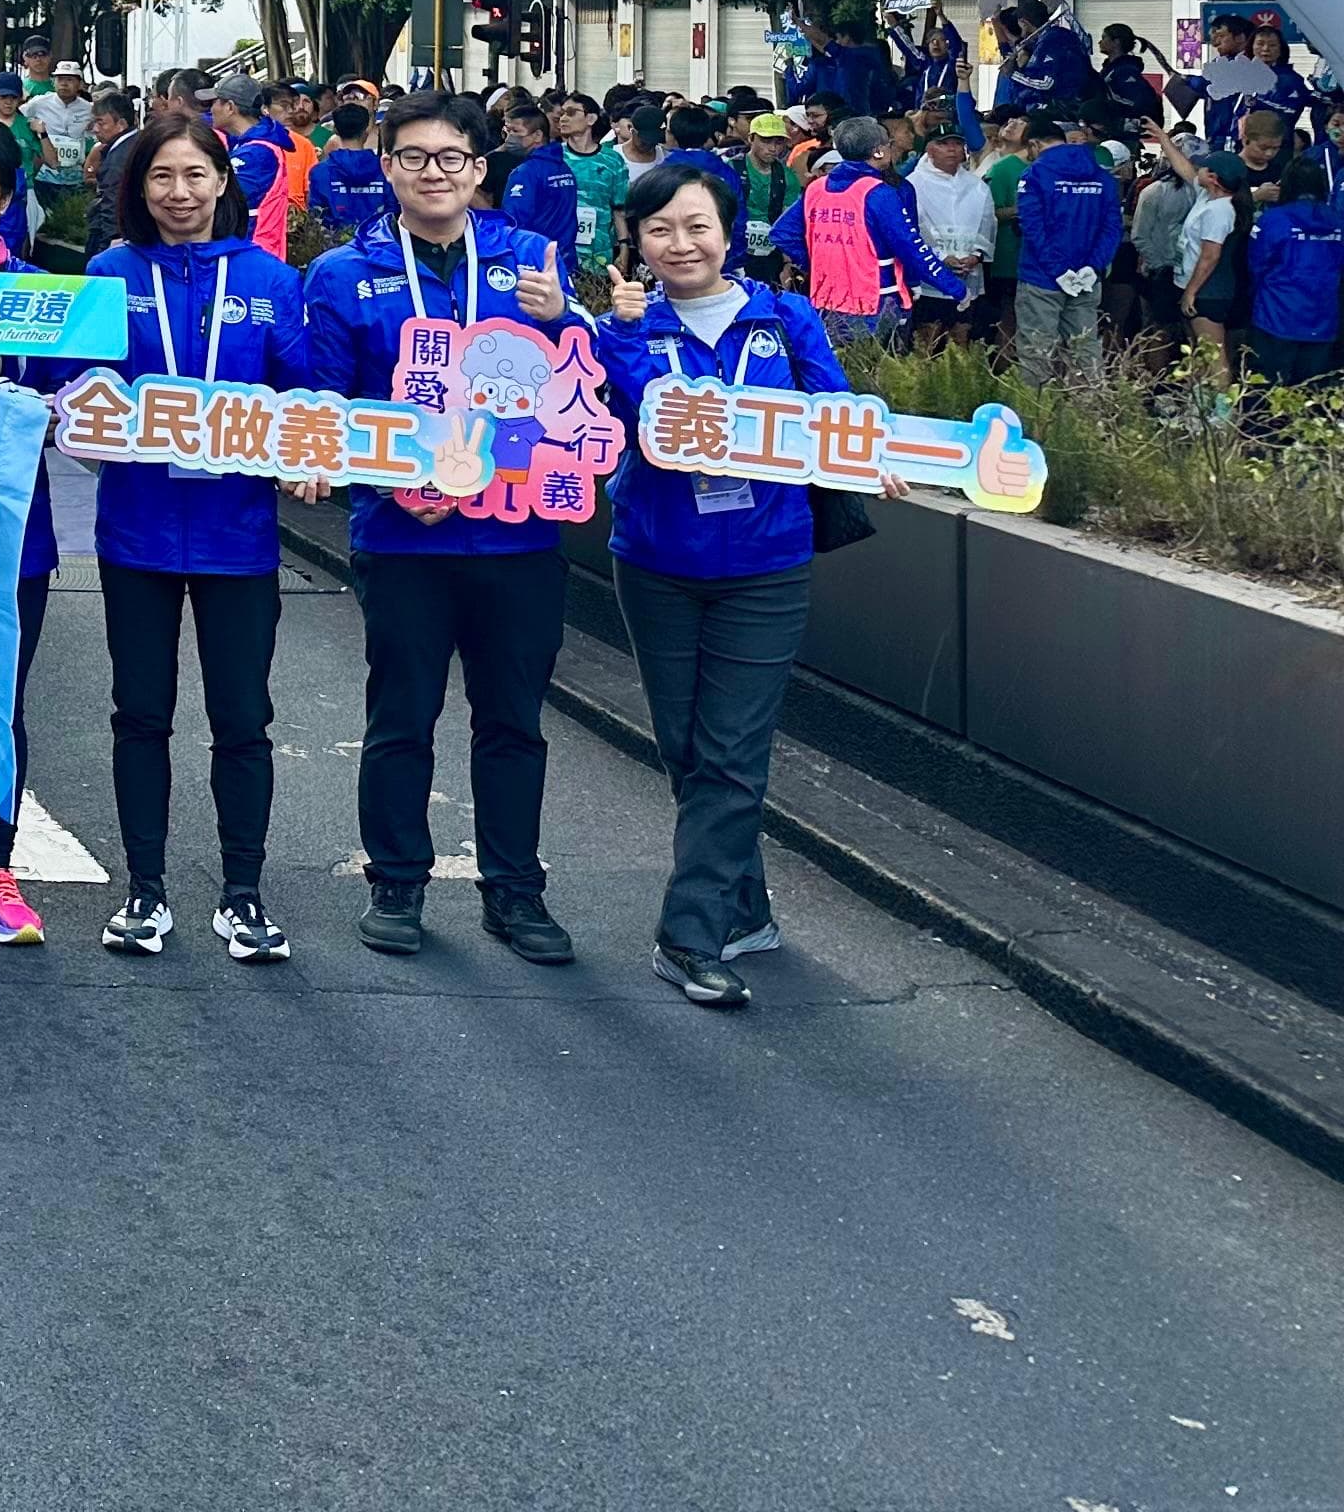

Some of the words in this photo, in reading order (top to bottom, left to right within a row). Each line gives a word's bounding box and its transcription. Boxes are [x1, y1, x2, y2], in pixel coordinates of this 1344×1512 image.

[3, 328, 58, 343] further!
[68, 381, 416, 475] 全民做義工
[654, 386, 963, 479] 義工世一
